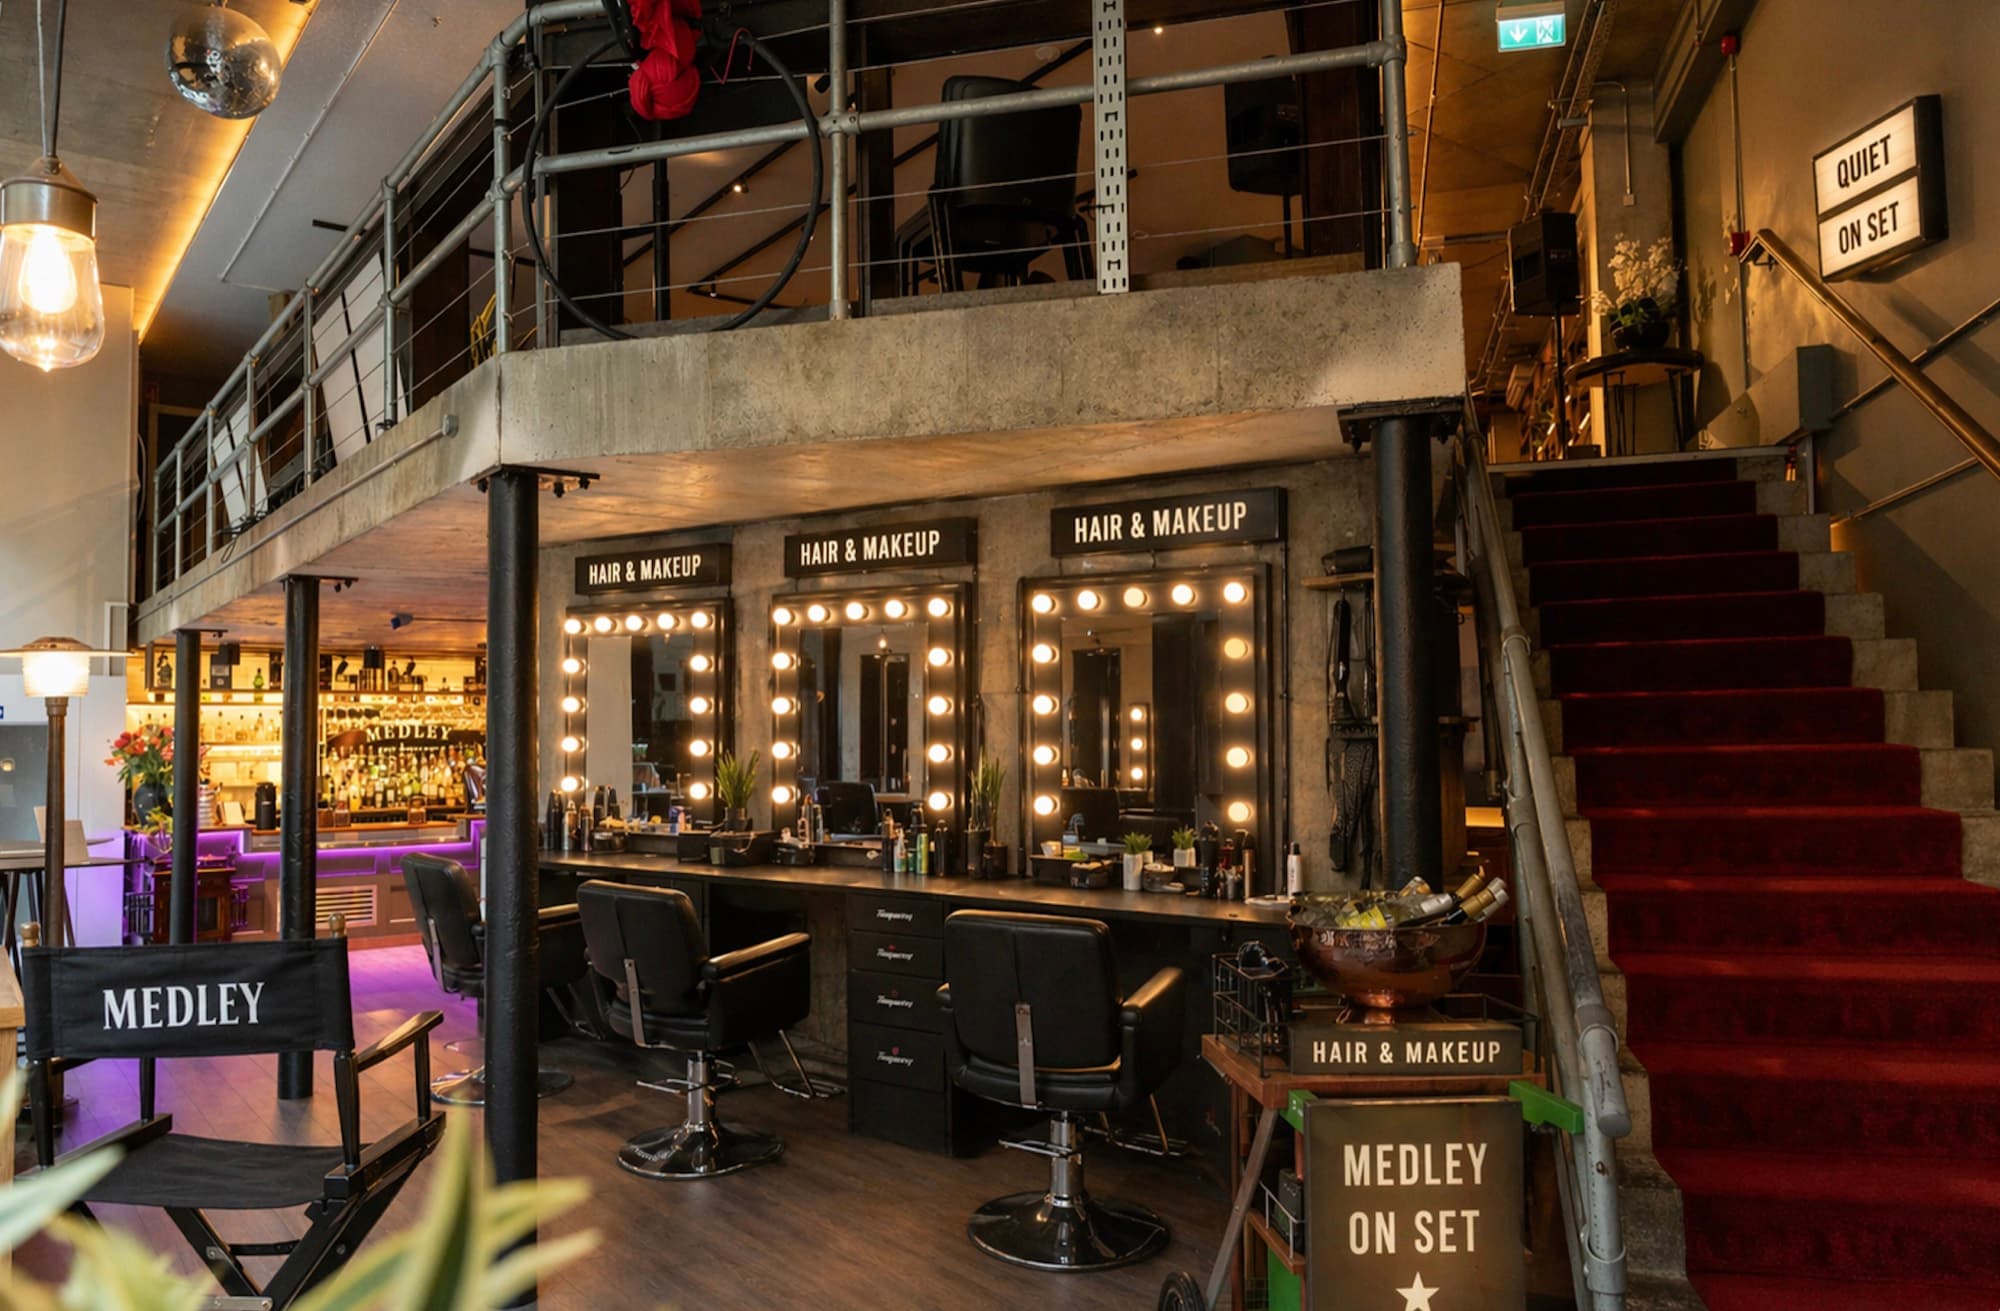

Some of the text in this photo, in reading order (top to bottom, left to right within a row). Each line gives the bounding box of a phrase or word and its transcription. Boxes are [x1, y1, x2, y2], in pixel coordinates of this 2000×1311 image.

[1837, 134, 1891, 189] QUIET
[1838, 201, 1899, 254] ON SET
[1075, 501, 1247, 543] HAIR & MAKEUP
[801, 530, 940, 566] HAIR & MAKEUP
[589, 554, 701, 585] HAIR & MAKEUP
[366, 724, 451, 742] MEDLEY
[103, 982, 264, 1030] MEDLEY
[1313, 1041, 1501, 1063] HAIR & MAKEUP
[1343, 1143, 1487, 1186] MEDLEY
[1350, 1209, 1480, 1254] ON SET
